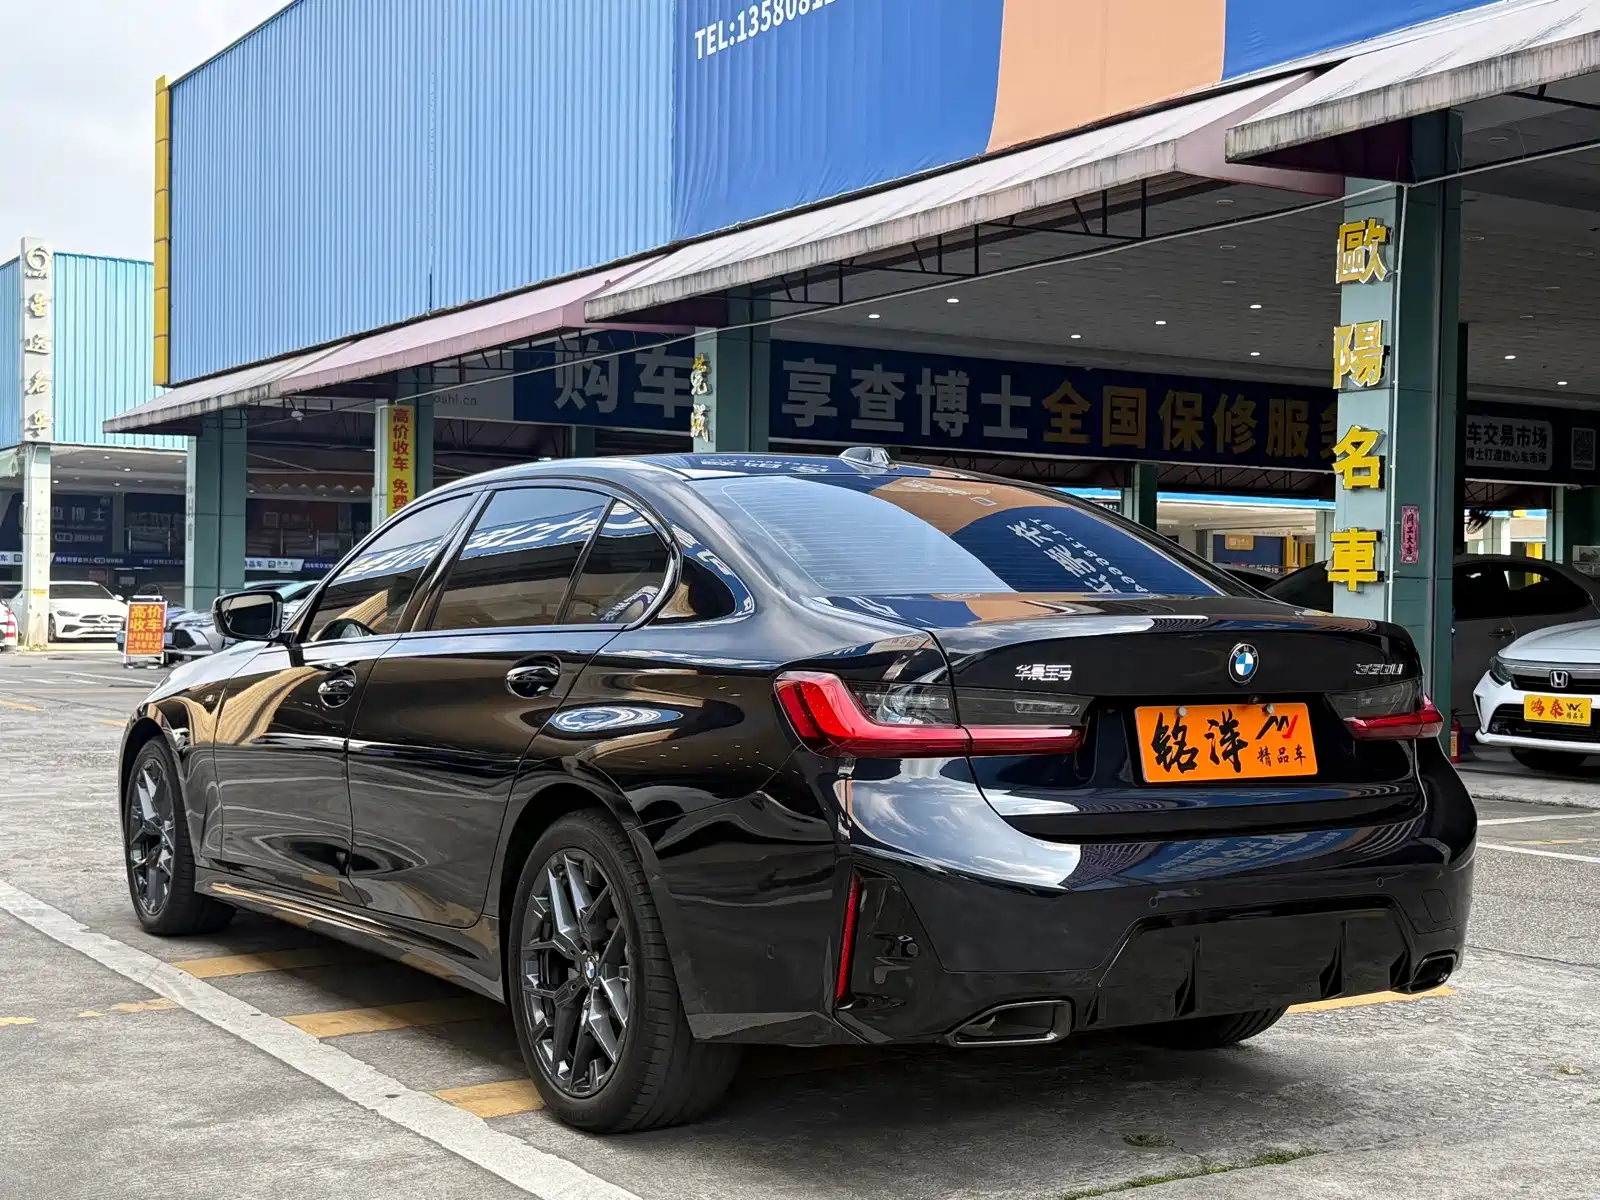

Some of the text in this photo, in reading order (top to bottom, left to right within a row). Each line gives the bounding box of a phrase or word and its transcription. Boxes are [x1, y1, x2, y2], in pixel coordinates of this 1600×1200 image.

[554, 337, 694, 419] 购车
[1329, 218, 1390, 592] 歐陽名車
[392, 408, 409, 472] 高价收车
[1467, 422, 1548, 449] 车交易市场
[131, 605, 163, 618] 高价
[130, 619, 162, 632] 收车
[1015, 664, 1072, 681] 华晨宝马
[1151, 708, 1249, 774] 铭洋
[1256, 744, 1307, 768] 精品车
